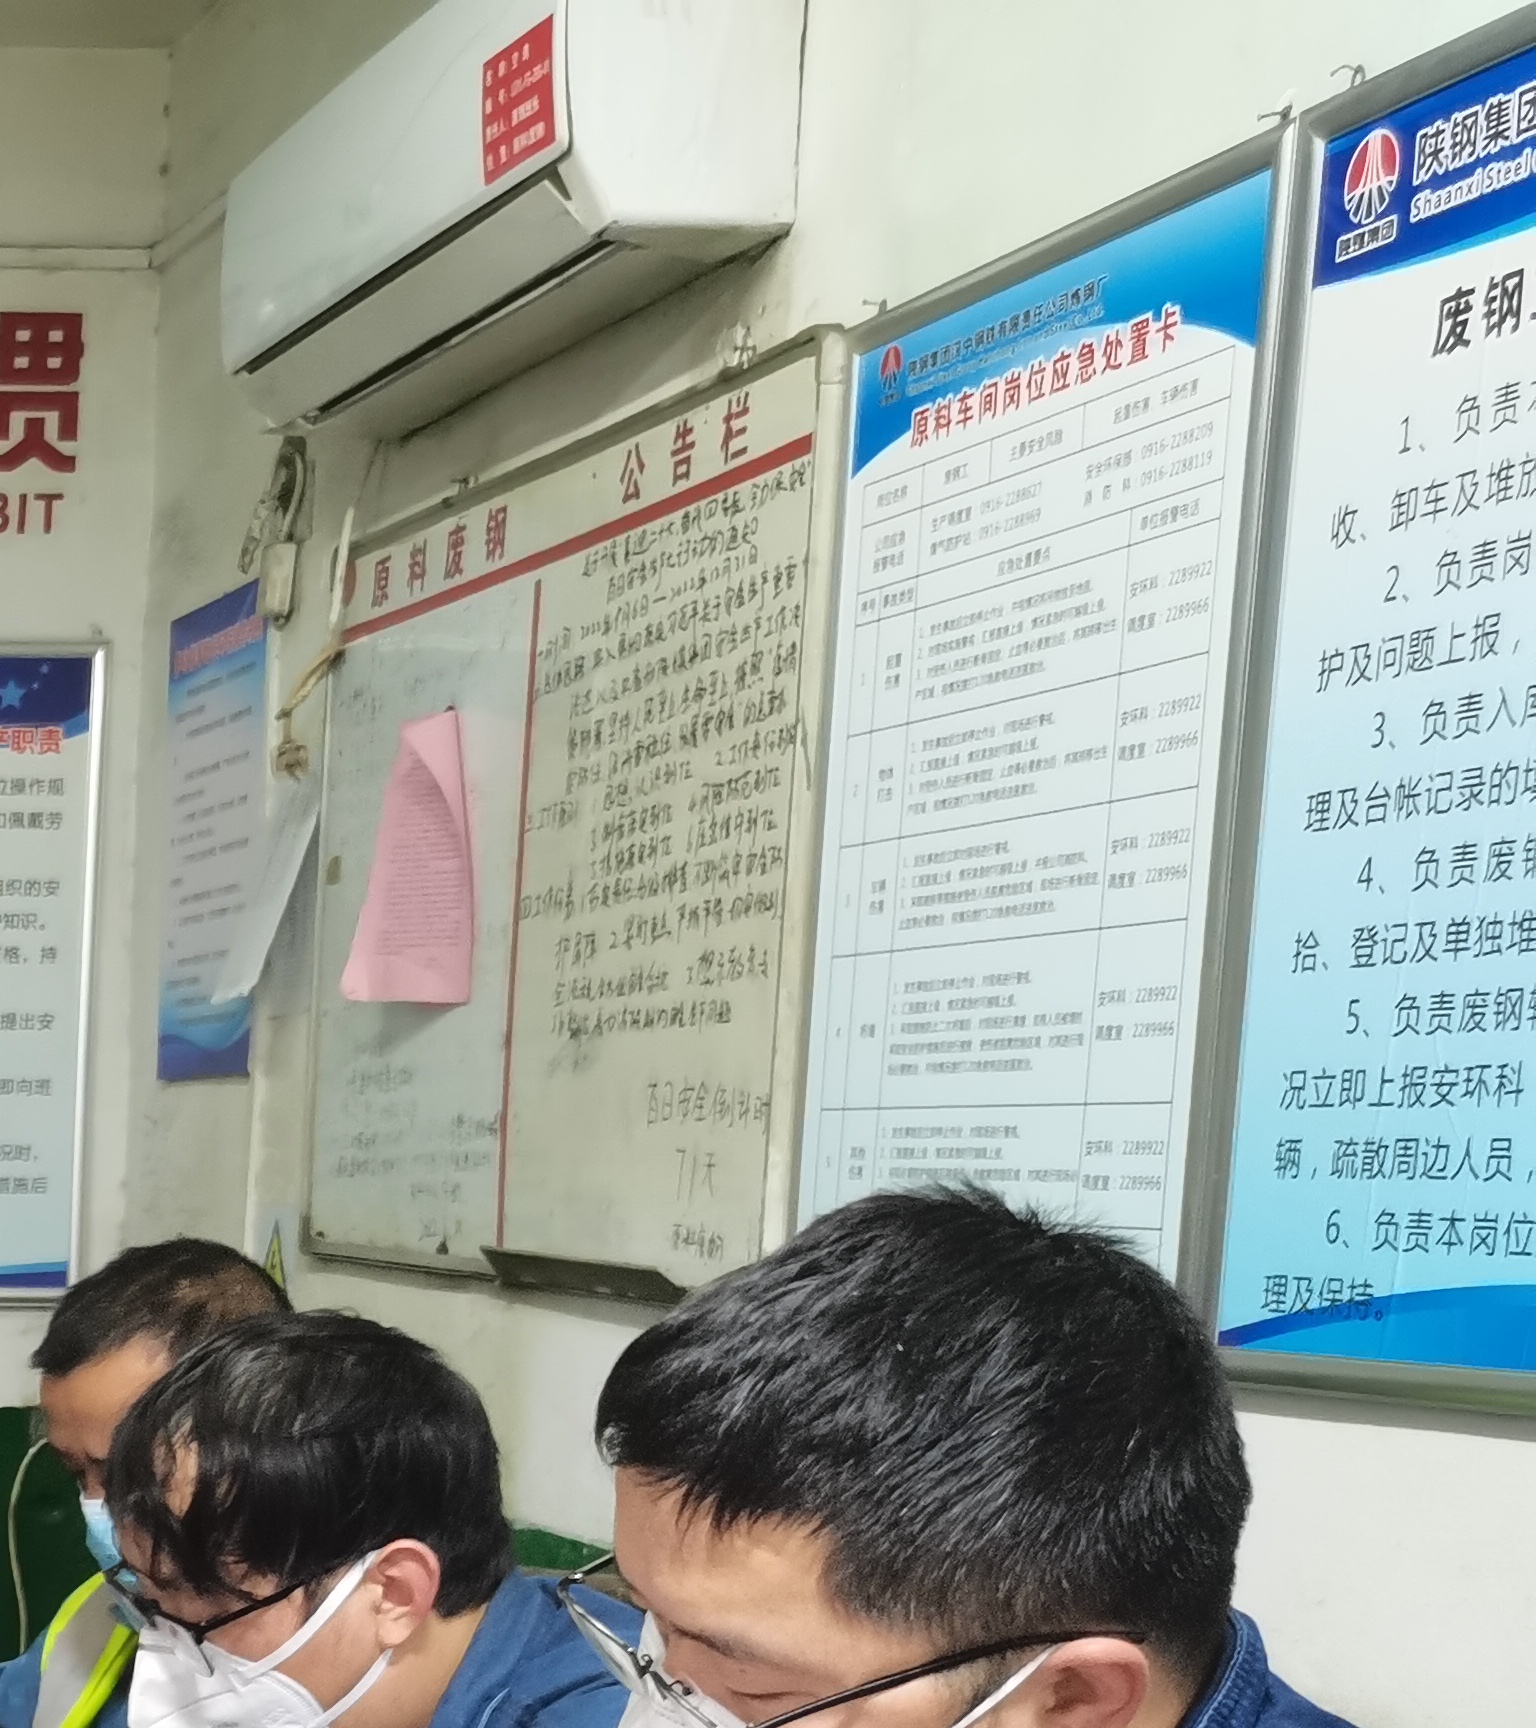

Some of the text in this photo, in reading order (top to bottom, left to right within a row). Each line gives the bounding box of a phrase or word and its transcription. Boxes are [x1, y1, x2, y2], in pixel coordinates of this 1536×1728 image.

[1414, 84, 1536, 184] 陕钢集团
[1412, 149, 1528, 221] Shaanxi Steel
[1430, 267, 1536, 358] 废钢
[909, 306, 1180, 449] 原料车间岗位应急处置卡
[1399, 380, 1536, 456] 1、负责
[370, 503, 509, 609] 原料废钢
[619, 390, 751, 504] 公告栏
[1279, 1060, 1525, 1110] 况立即上报安环科
[1260, 1274, 1384, 1322] 理及保持。
